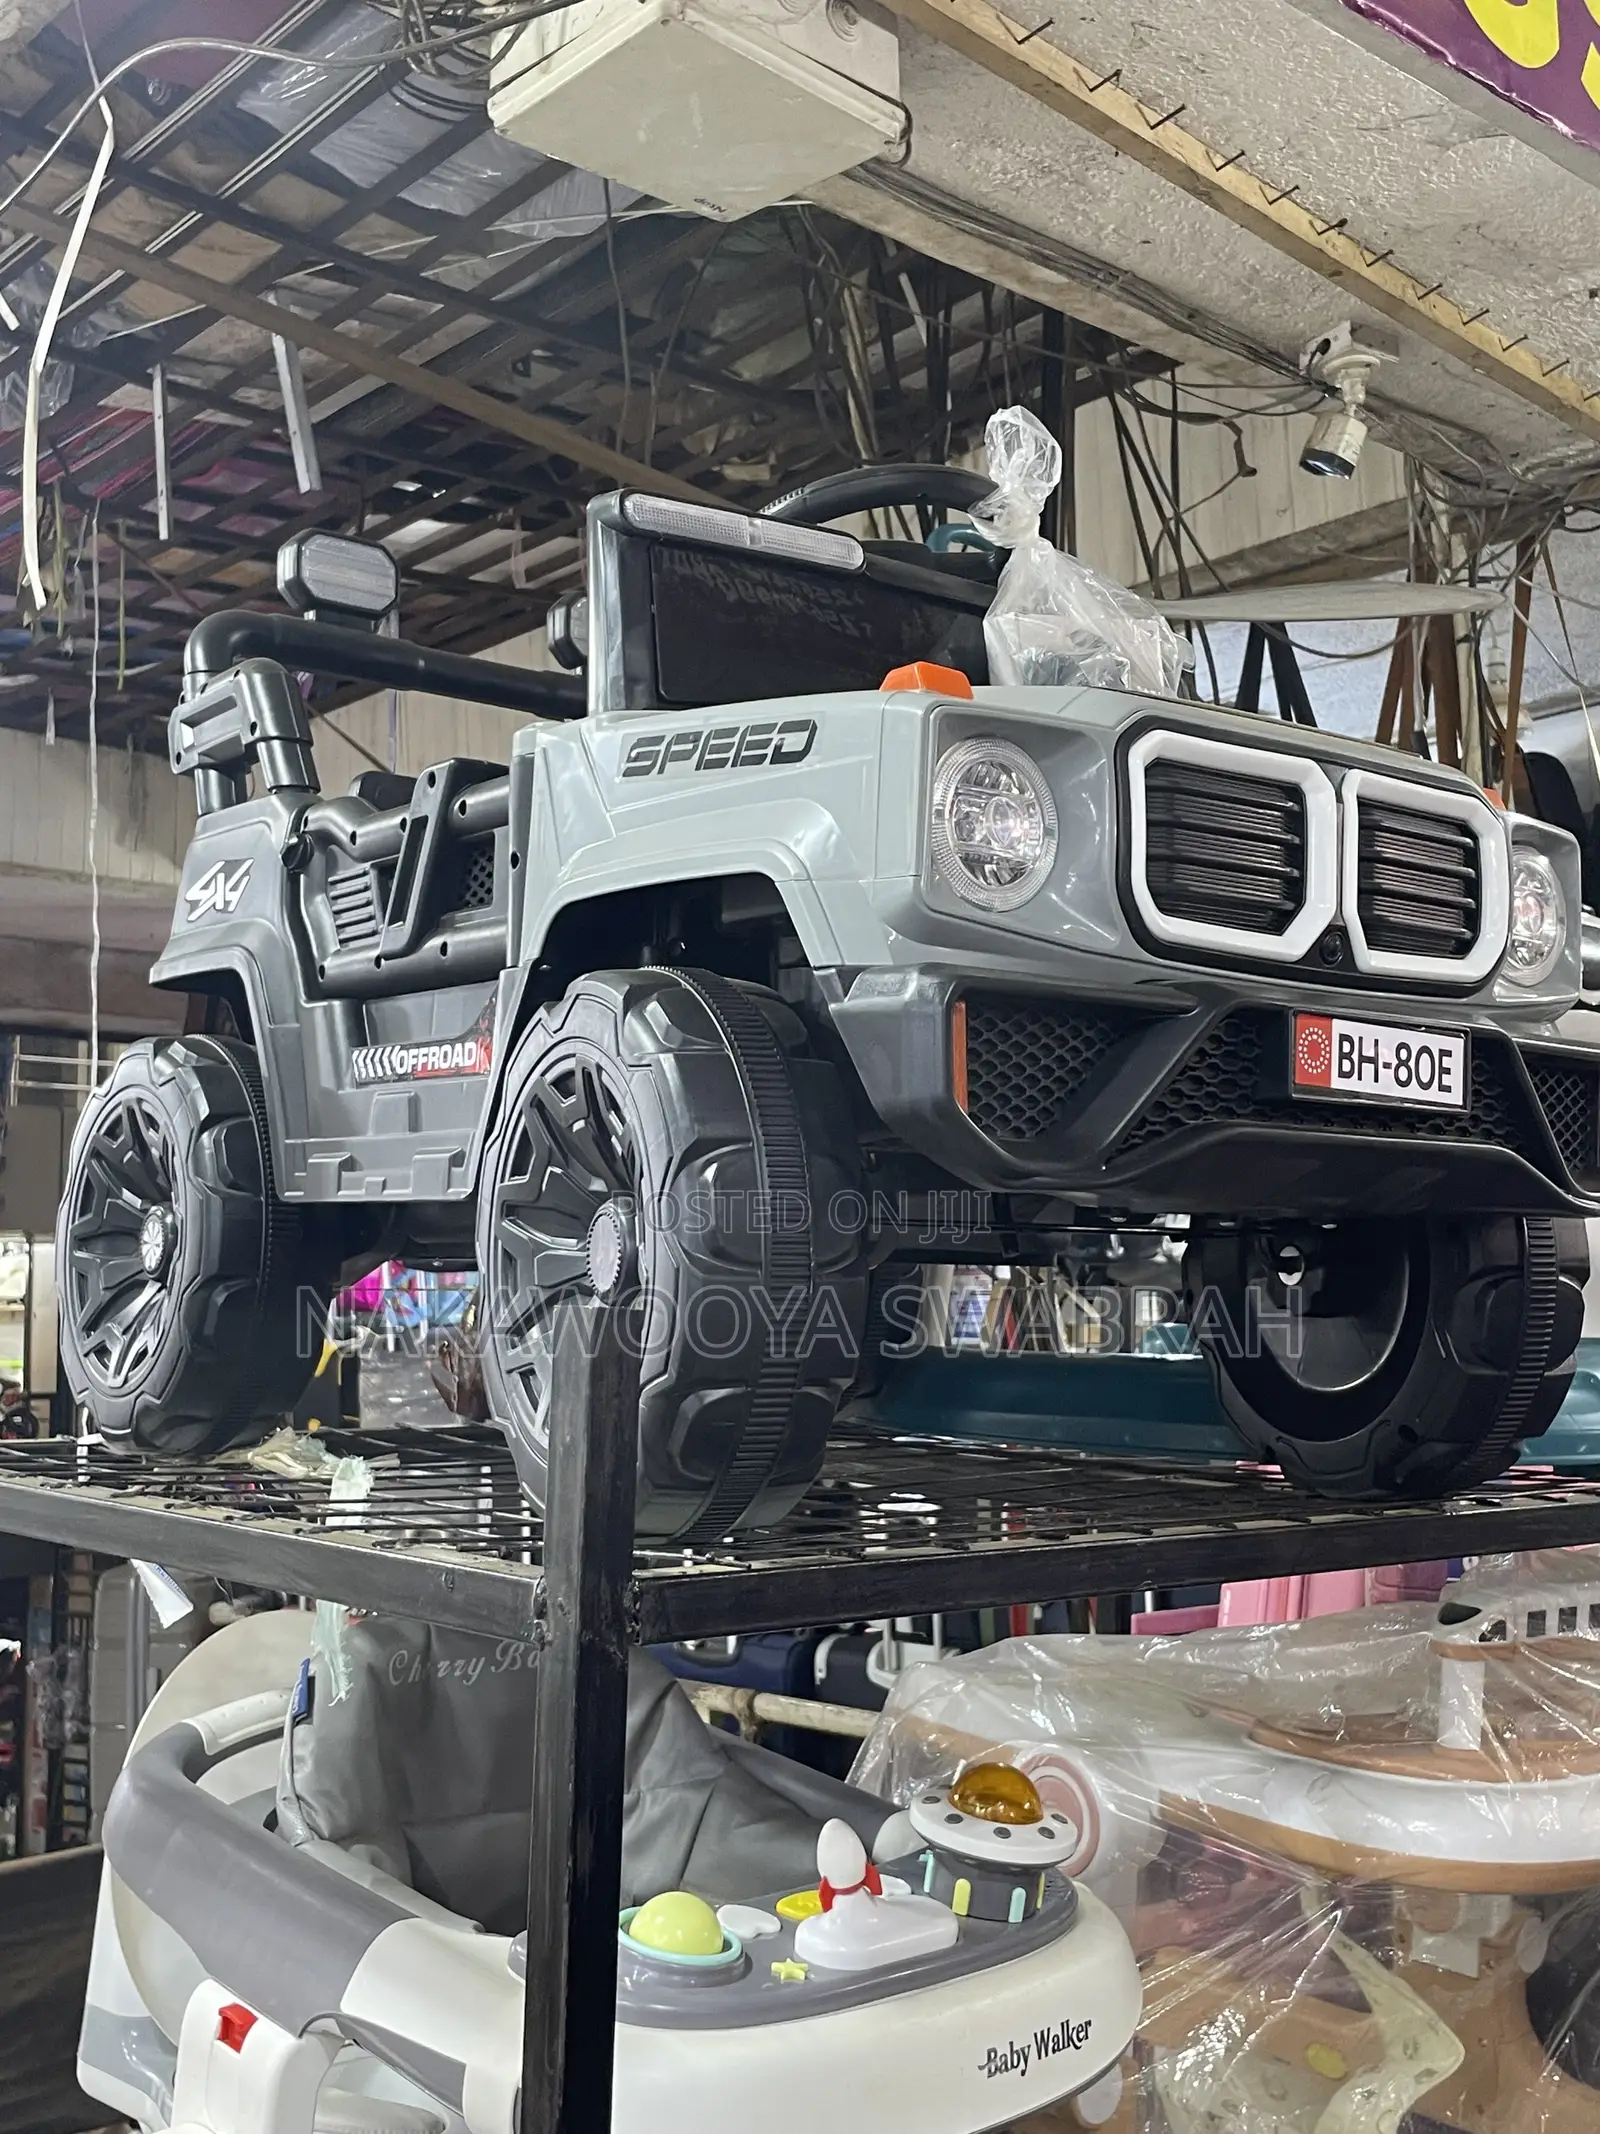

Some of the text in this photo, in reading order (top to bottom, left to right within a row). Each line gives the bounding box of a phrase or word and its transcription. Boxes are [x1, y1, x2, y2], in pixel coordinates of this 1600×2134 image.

[622, 719, 818, 778] SPEED
[395, 1041, 477, 1075] OFFROAD
[388, 1650, 486, 1686] Chrry
[977, 2019, 1092, 2079] Baby Walker
